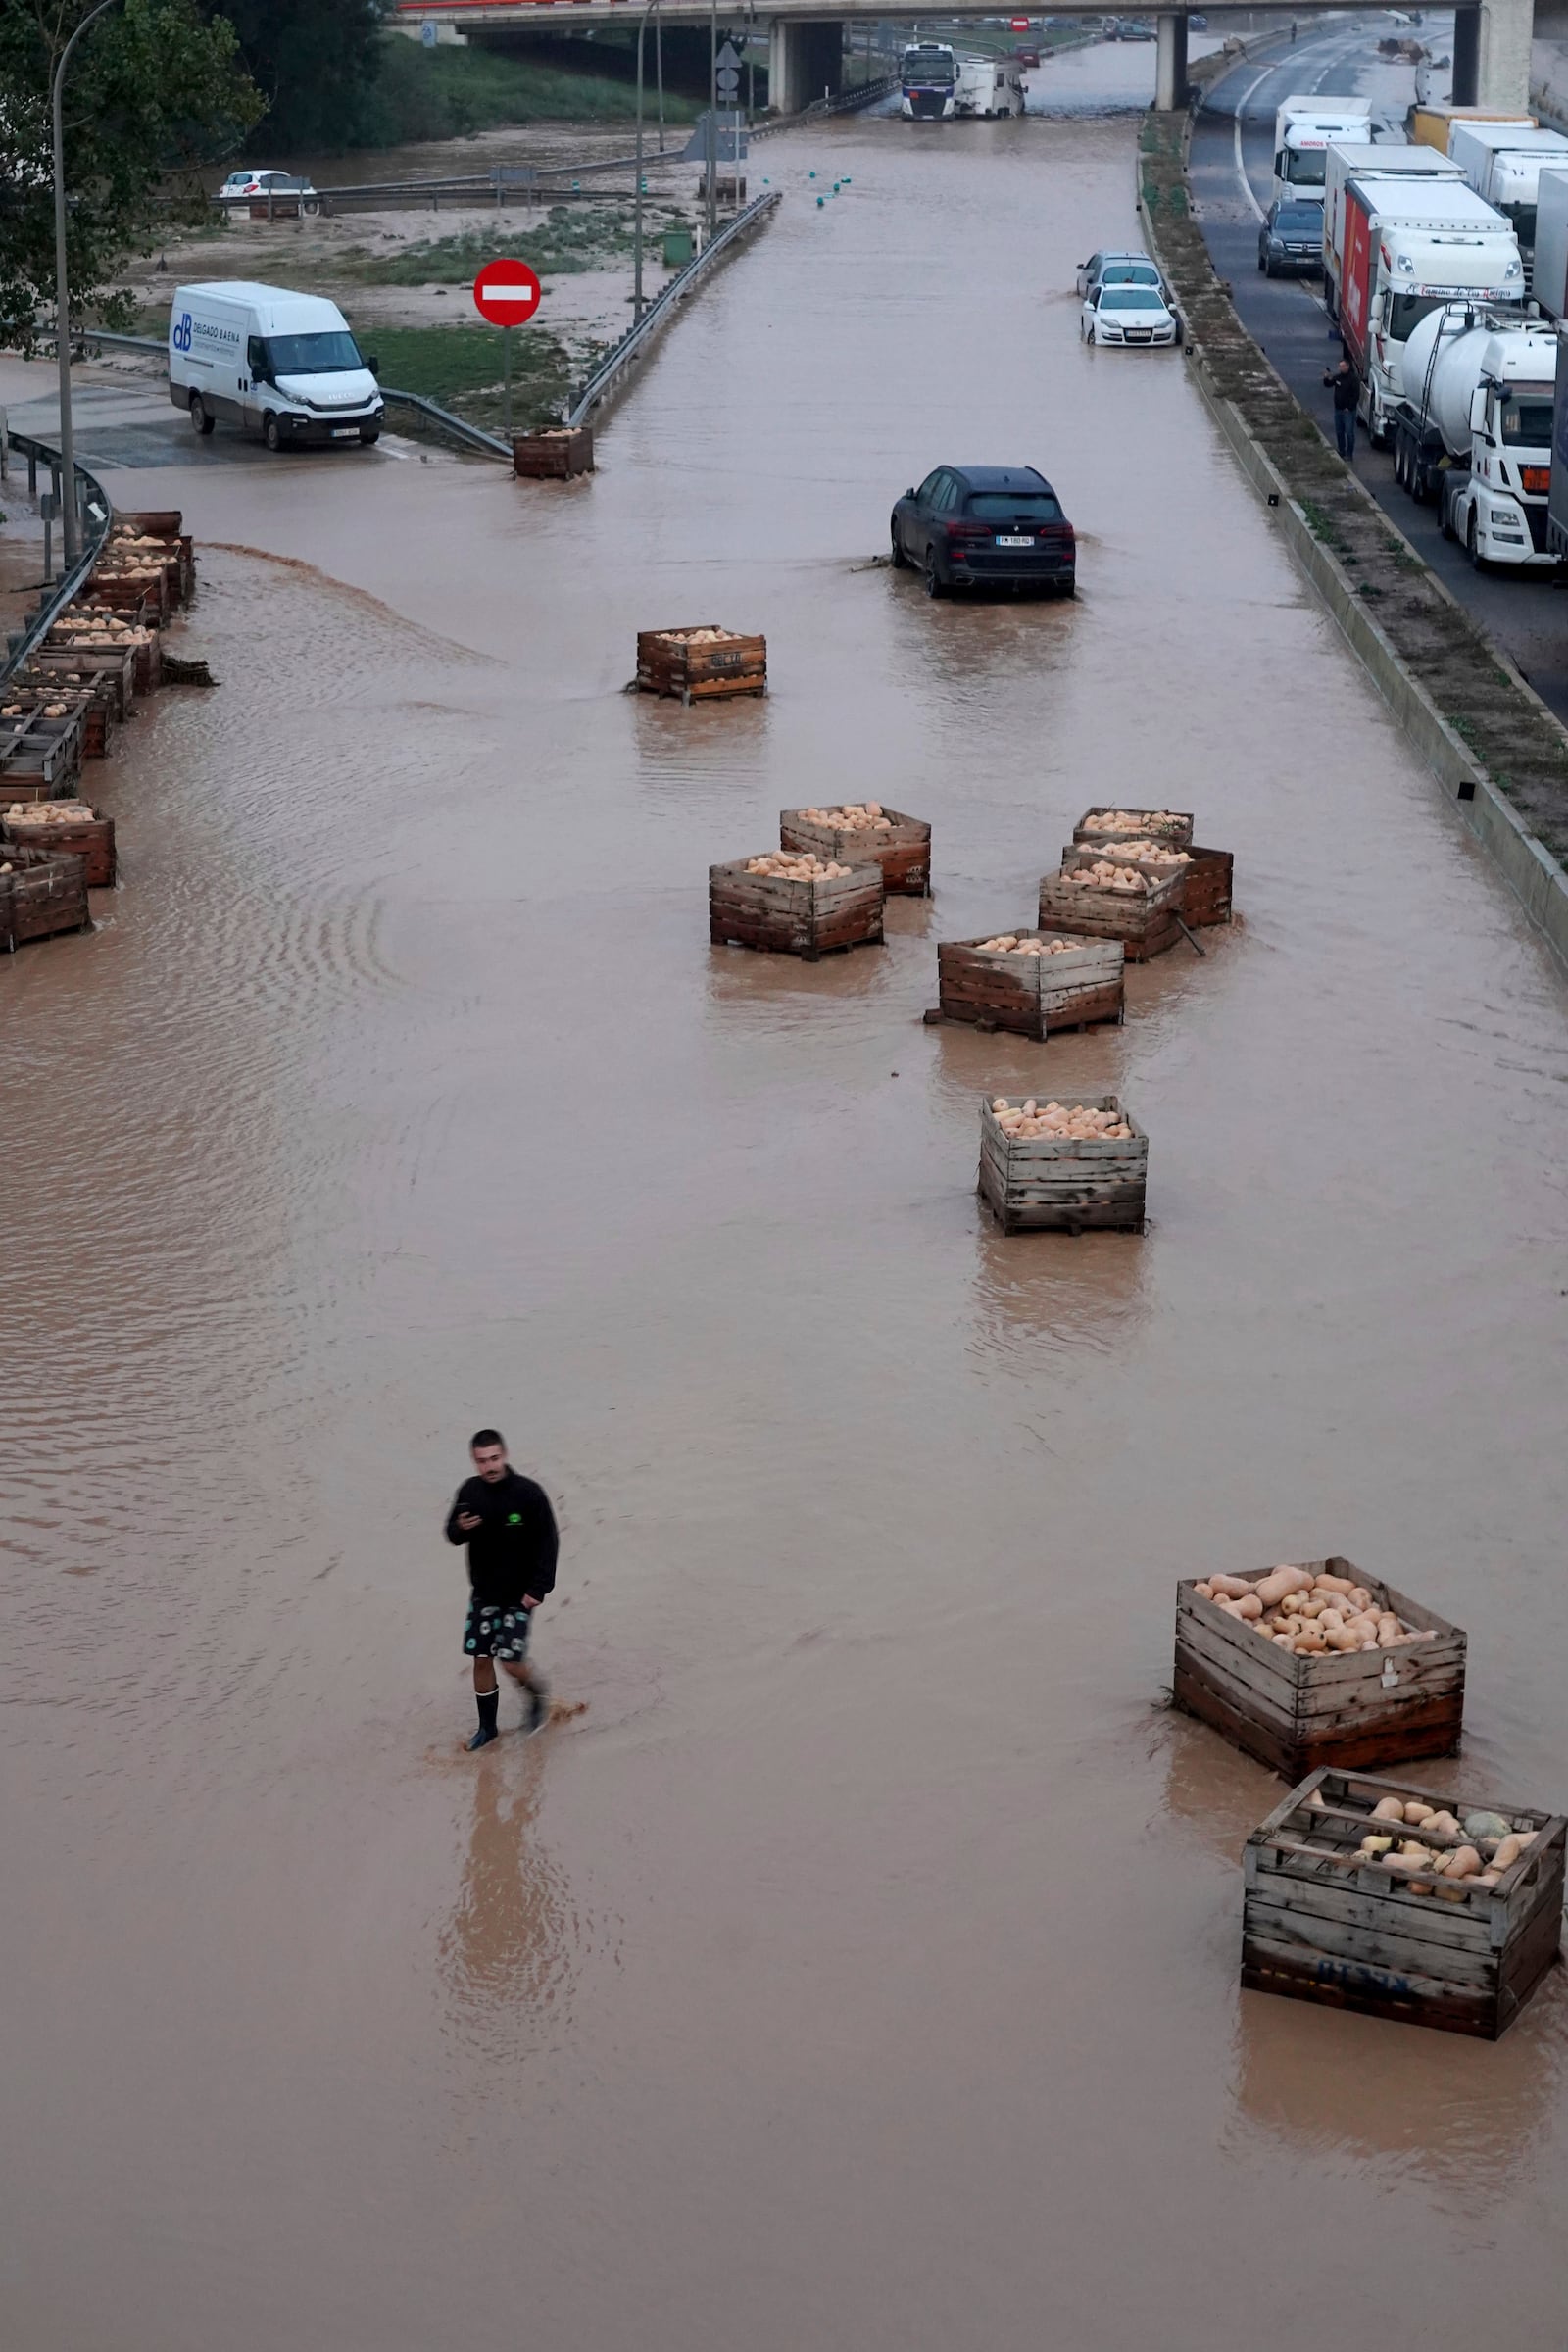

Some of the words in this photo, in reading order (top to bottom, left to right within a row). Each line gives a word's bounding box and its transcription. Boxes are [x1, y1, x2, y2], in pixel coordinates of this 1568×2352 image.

[193, 322, 219, 338] DELGADO
[220, 328, 240, 343] BAENA
[328, 391, 355, 400] IVECO
